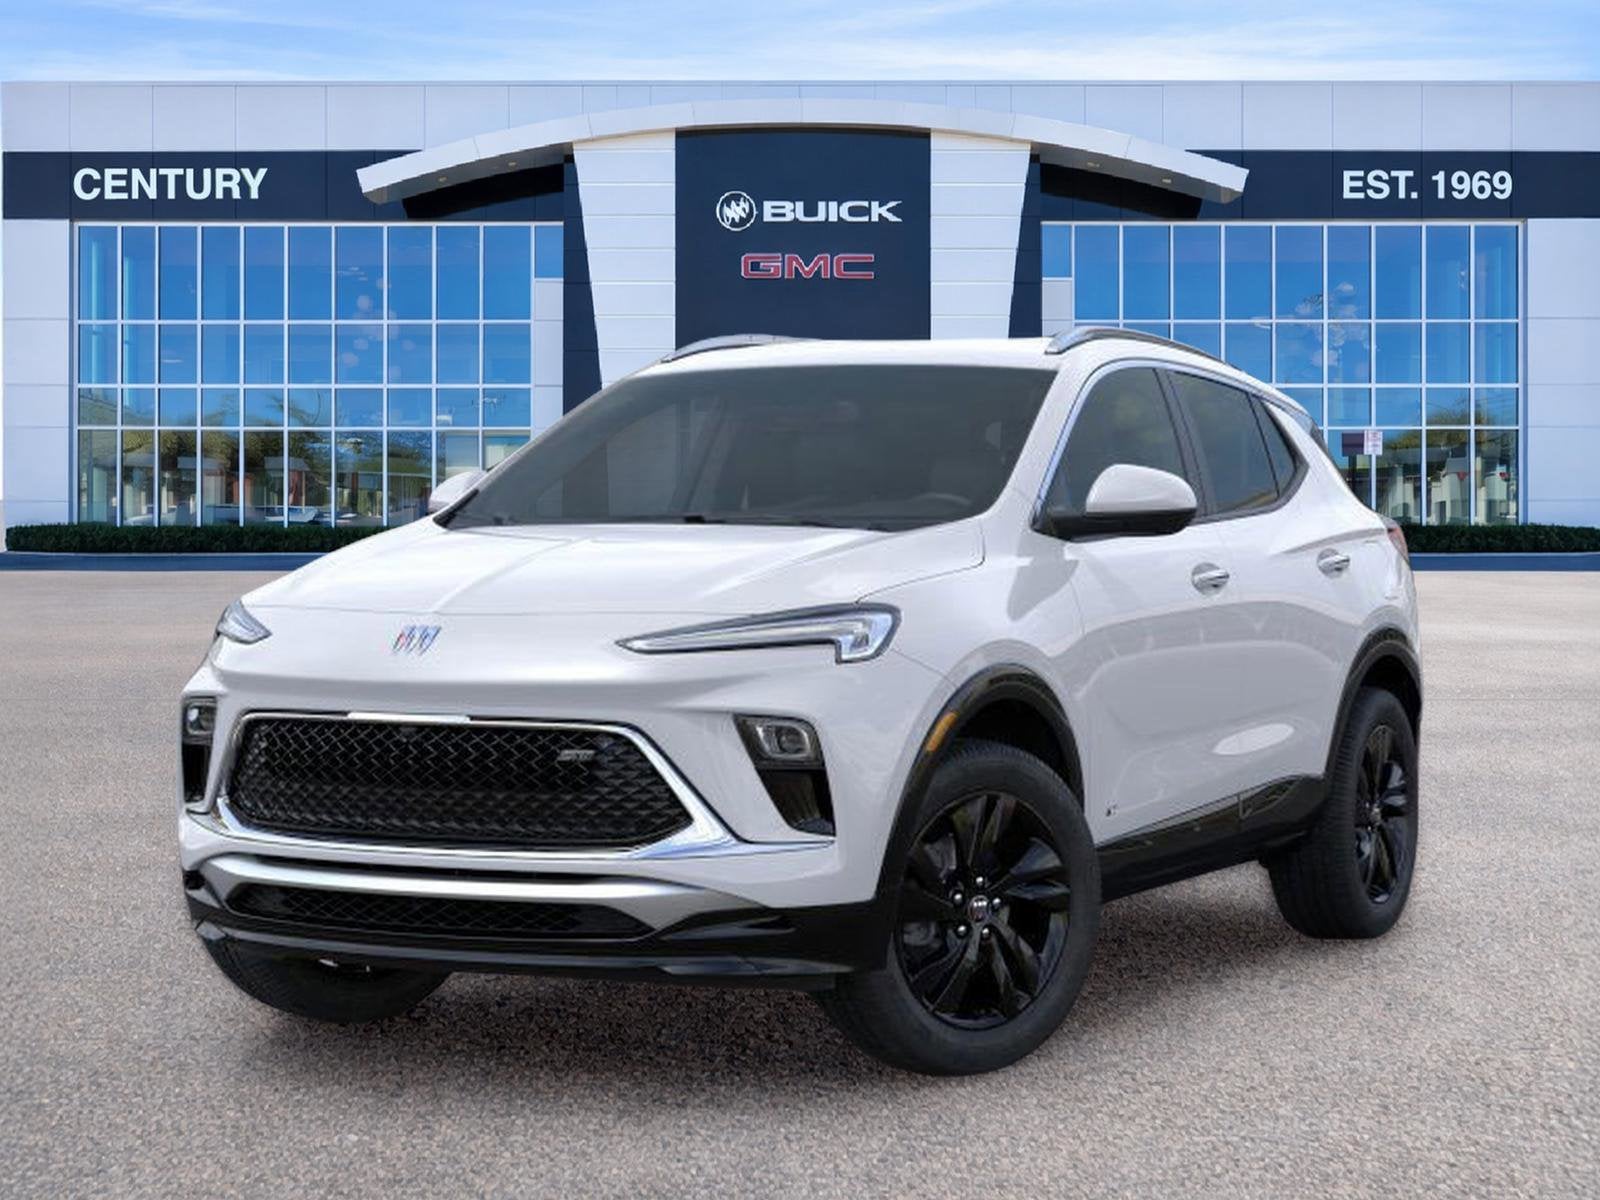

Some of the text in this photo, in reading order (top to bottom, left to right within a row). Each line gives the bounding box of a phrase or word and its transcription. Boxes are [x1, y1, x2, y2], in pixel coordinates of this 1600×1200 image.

[73, 167, 268, 200] CENTURY
[1342, 169, 1513, 200] EST. 1969
[763, 200, 903, 222] BUICK
[741, 253, 875, 279] GMC
